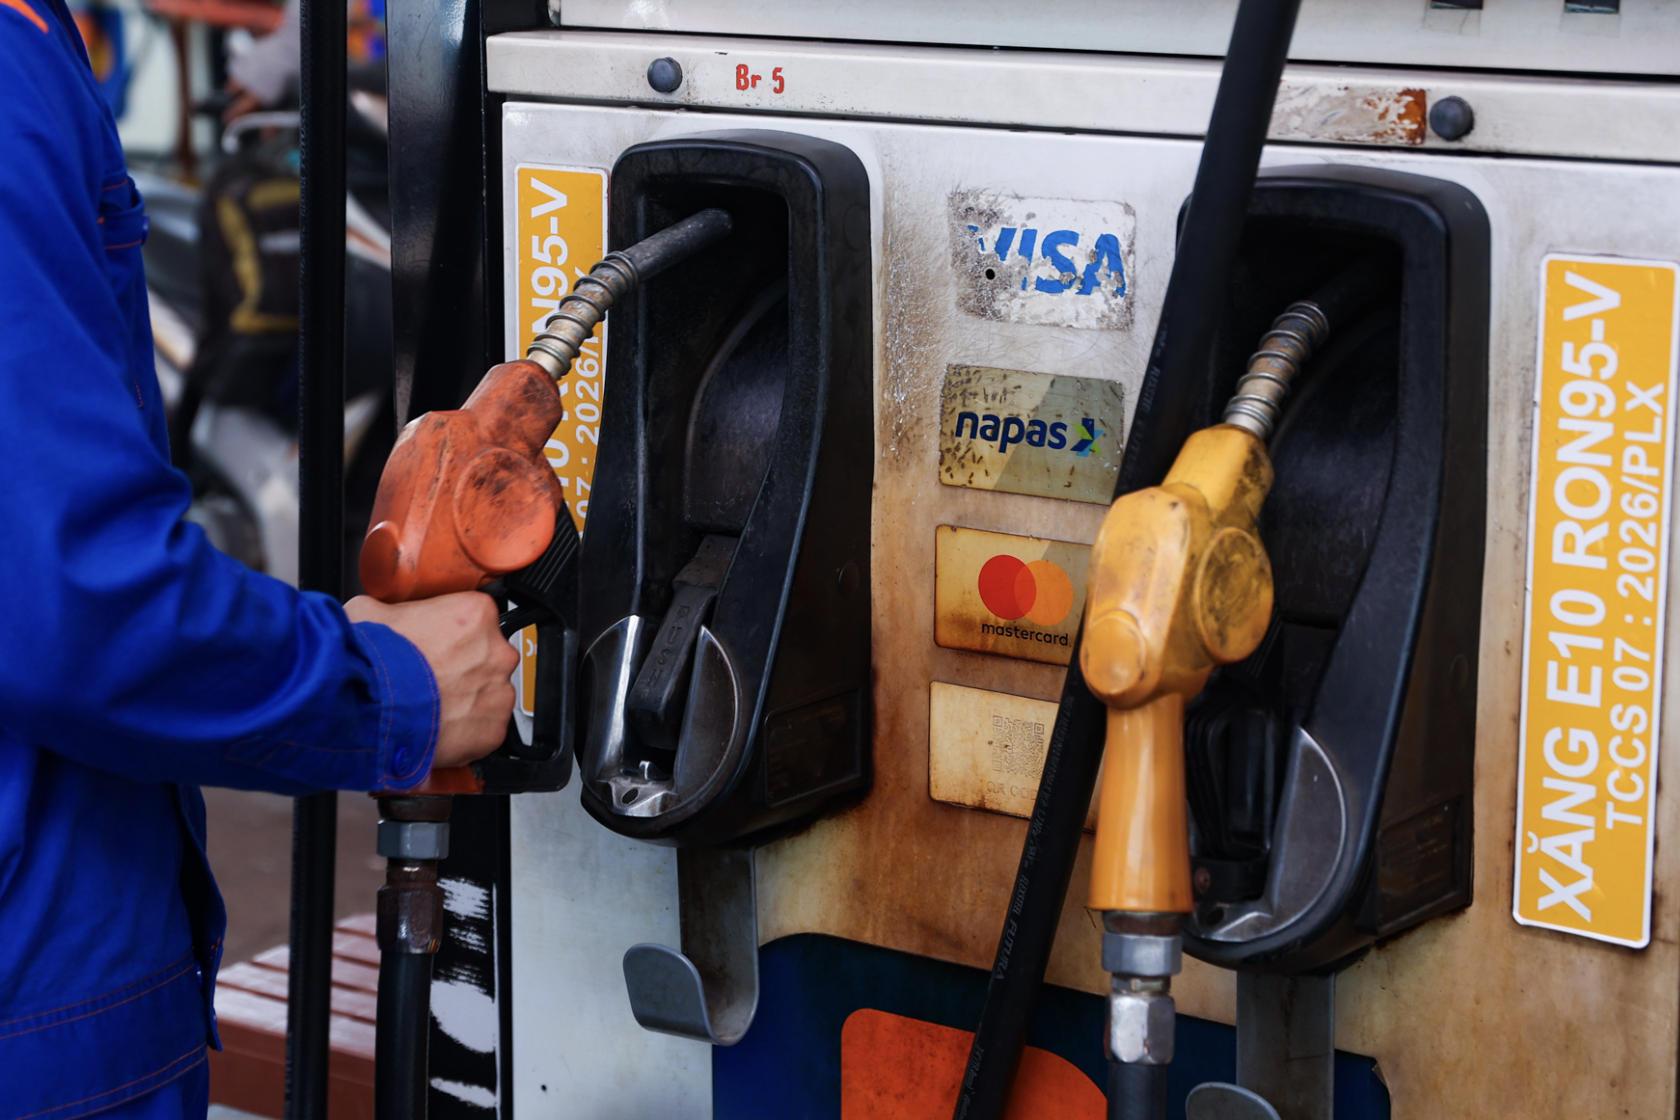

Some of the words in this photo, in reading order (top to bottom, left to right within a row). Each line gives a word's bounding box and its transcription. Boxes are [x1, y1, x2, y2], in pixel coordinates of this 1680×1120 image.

[735, 63, 762, 91] Br
[772, 67, 785, 94] 5
[955, 411, 1068, 454] napas
[1551, 270, 1622, 571] RON95-V
[1546, 588, 1606, 709] E10
[986, 780, 1006, 796] QR
[1009, 785, 1038, 801] COD
[1605, 703, 1649, 830] TCCS
[1526, 726, 1601, 924] XĂNG
[1013, 874, 1030, 916] FLEXSTEEL
[995, 919, 1018, 980] FUTURA
